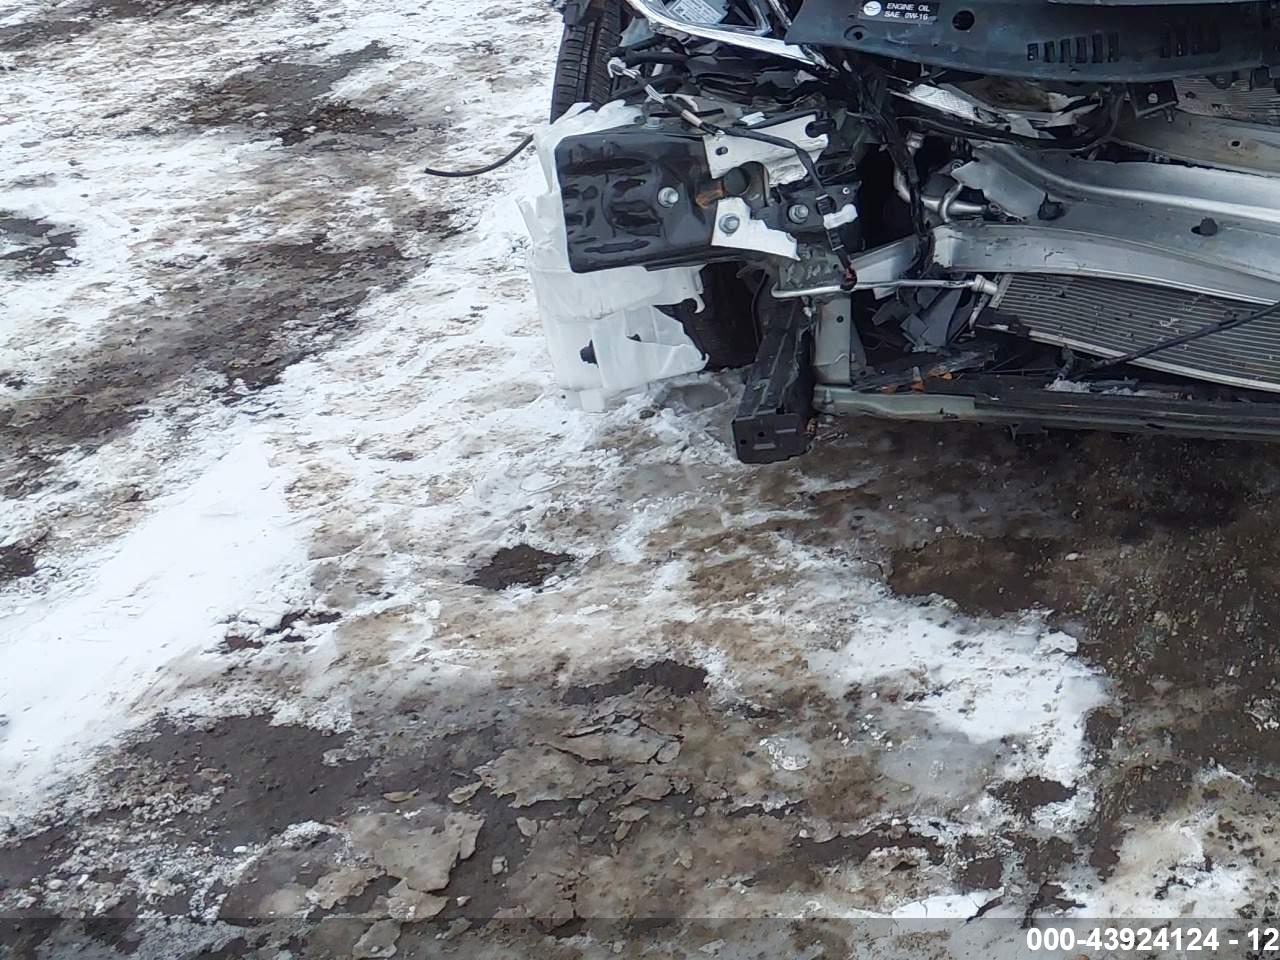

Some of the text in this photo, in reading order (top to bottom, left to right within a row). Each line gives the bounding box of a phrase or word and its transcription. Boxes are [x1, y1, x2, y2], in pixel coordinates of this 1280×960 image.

[886, 2, 931, 12] ENGINE OIL
[884, 10, 929, 20] SAE 0W-16
